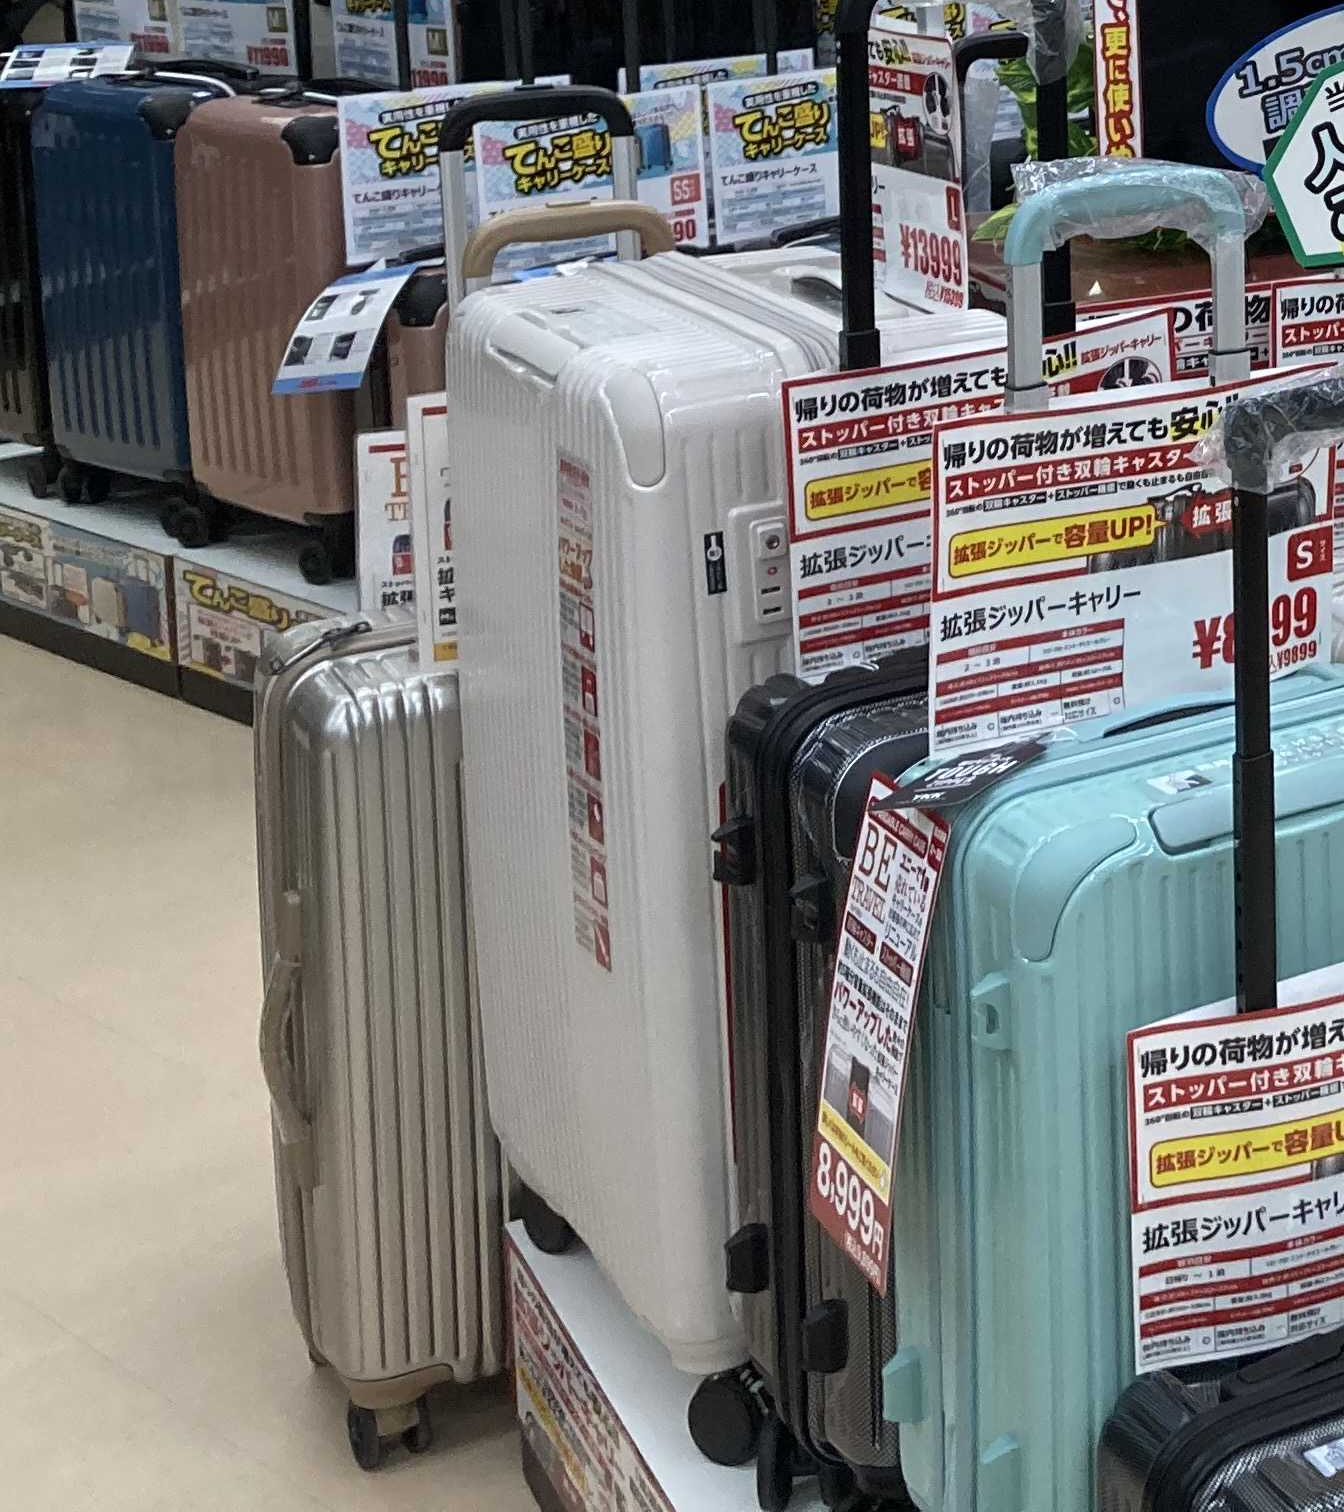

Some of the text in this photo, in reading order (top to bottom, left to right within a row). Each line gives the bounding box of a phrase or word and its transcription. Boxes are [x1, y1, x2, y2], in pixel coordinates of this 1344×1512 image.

[952, 514, 1154, 567] 拡張ジッパーで容量UP!
[1294, 541, 1313, 571] S
[940, 585, 1142, 642] 拡張ジッパーキャリー
